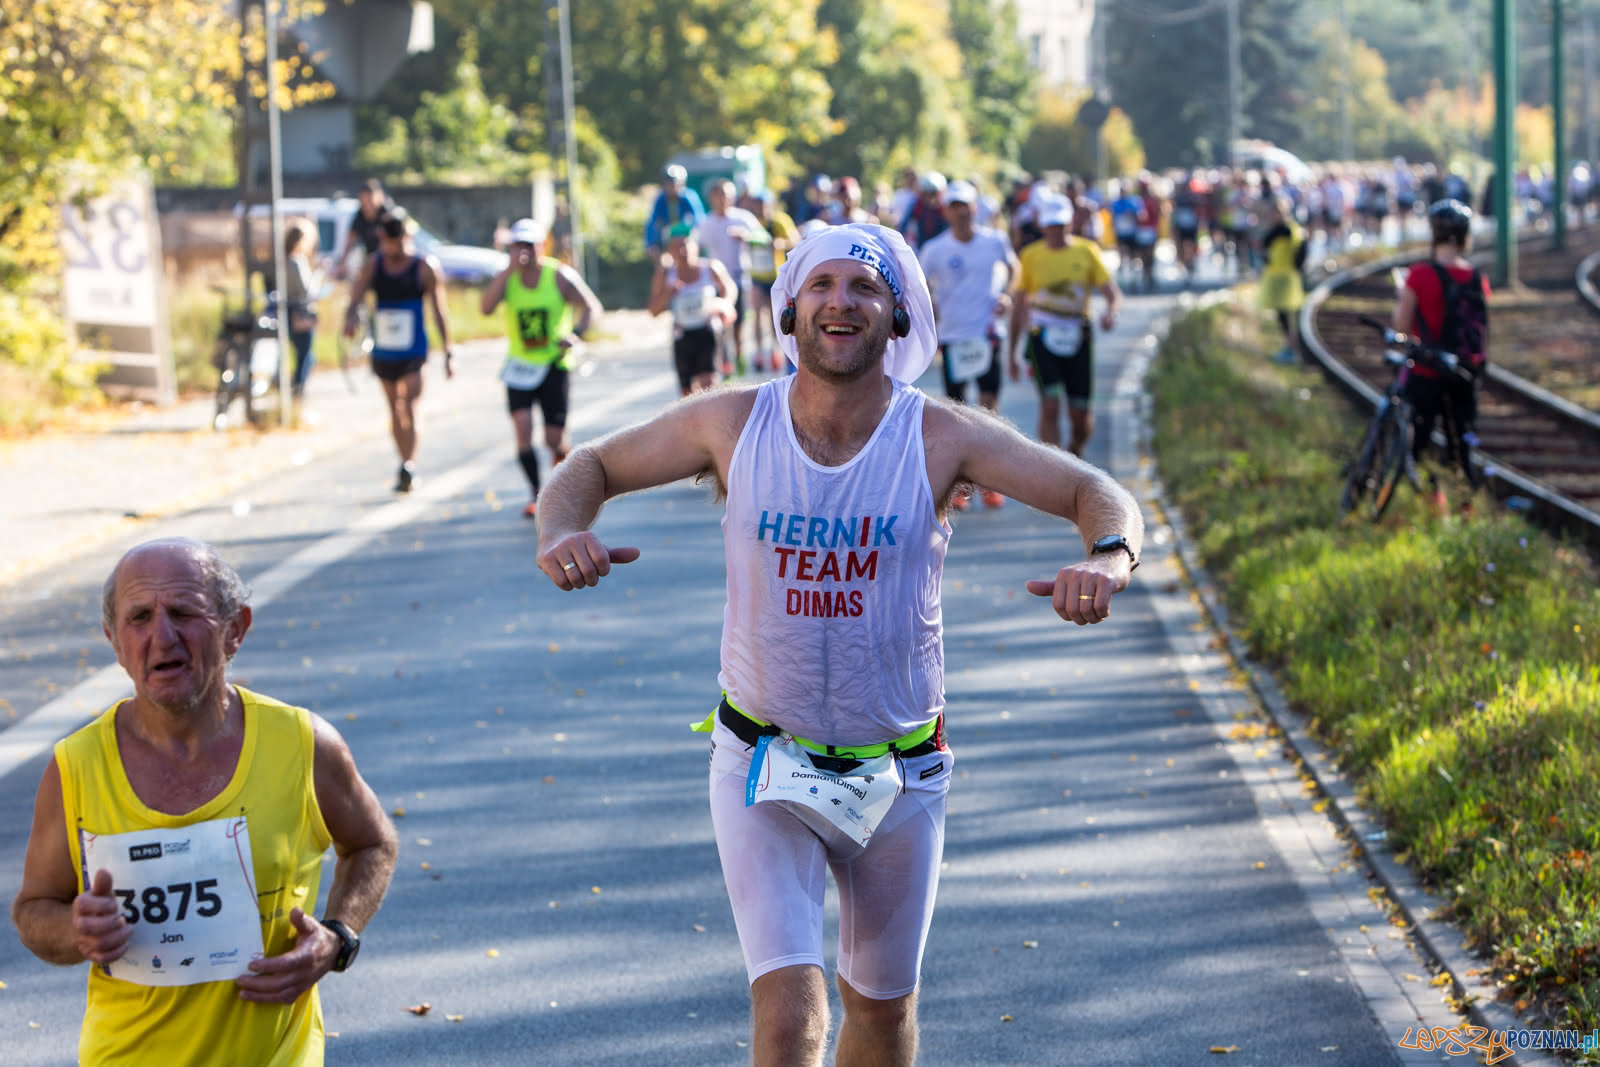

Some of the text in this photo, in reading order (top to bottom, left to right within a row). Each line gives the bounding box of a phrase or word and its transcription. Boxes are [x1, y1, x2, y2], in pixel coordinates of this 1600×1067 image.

[757, 510, 899, 548] HERNIK
[774, 547, 879, 582] TEAM
[786, 588, 864, 618] DIMAS
[114, 878, 223, 925] 3875
[159, 932, 185, 944] Jan
